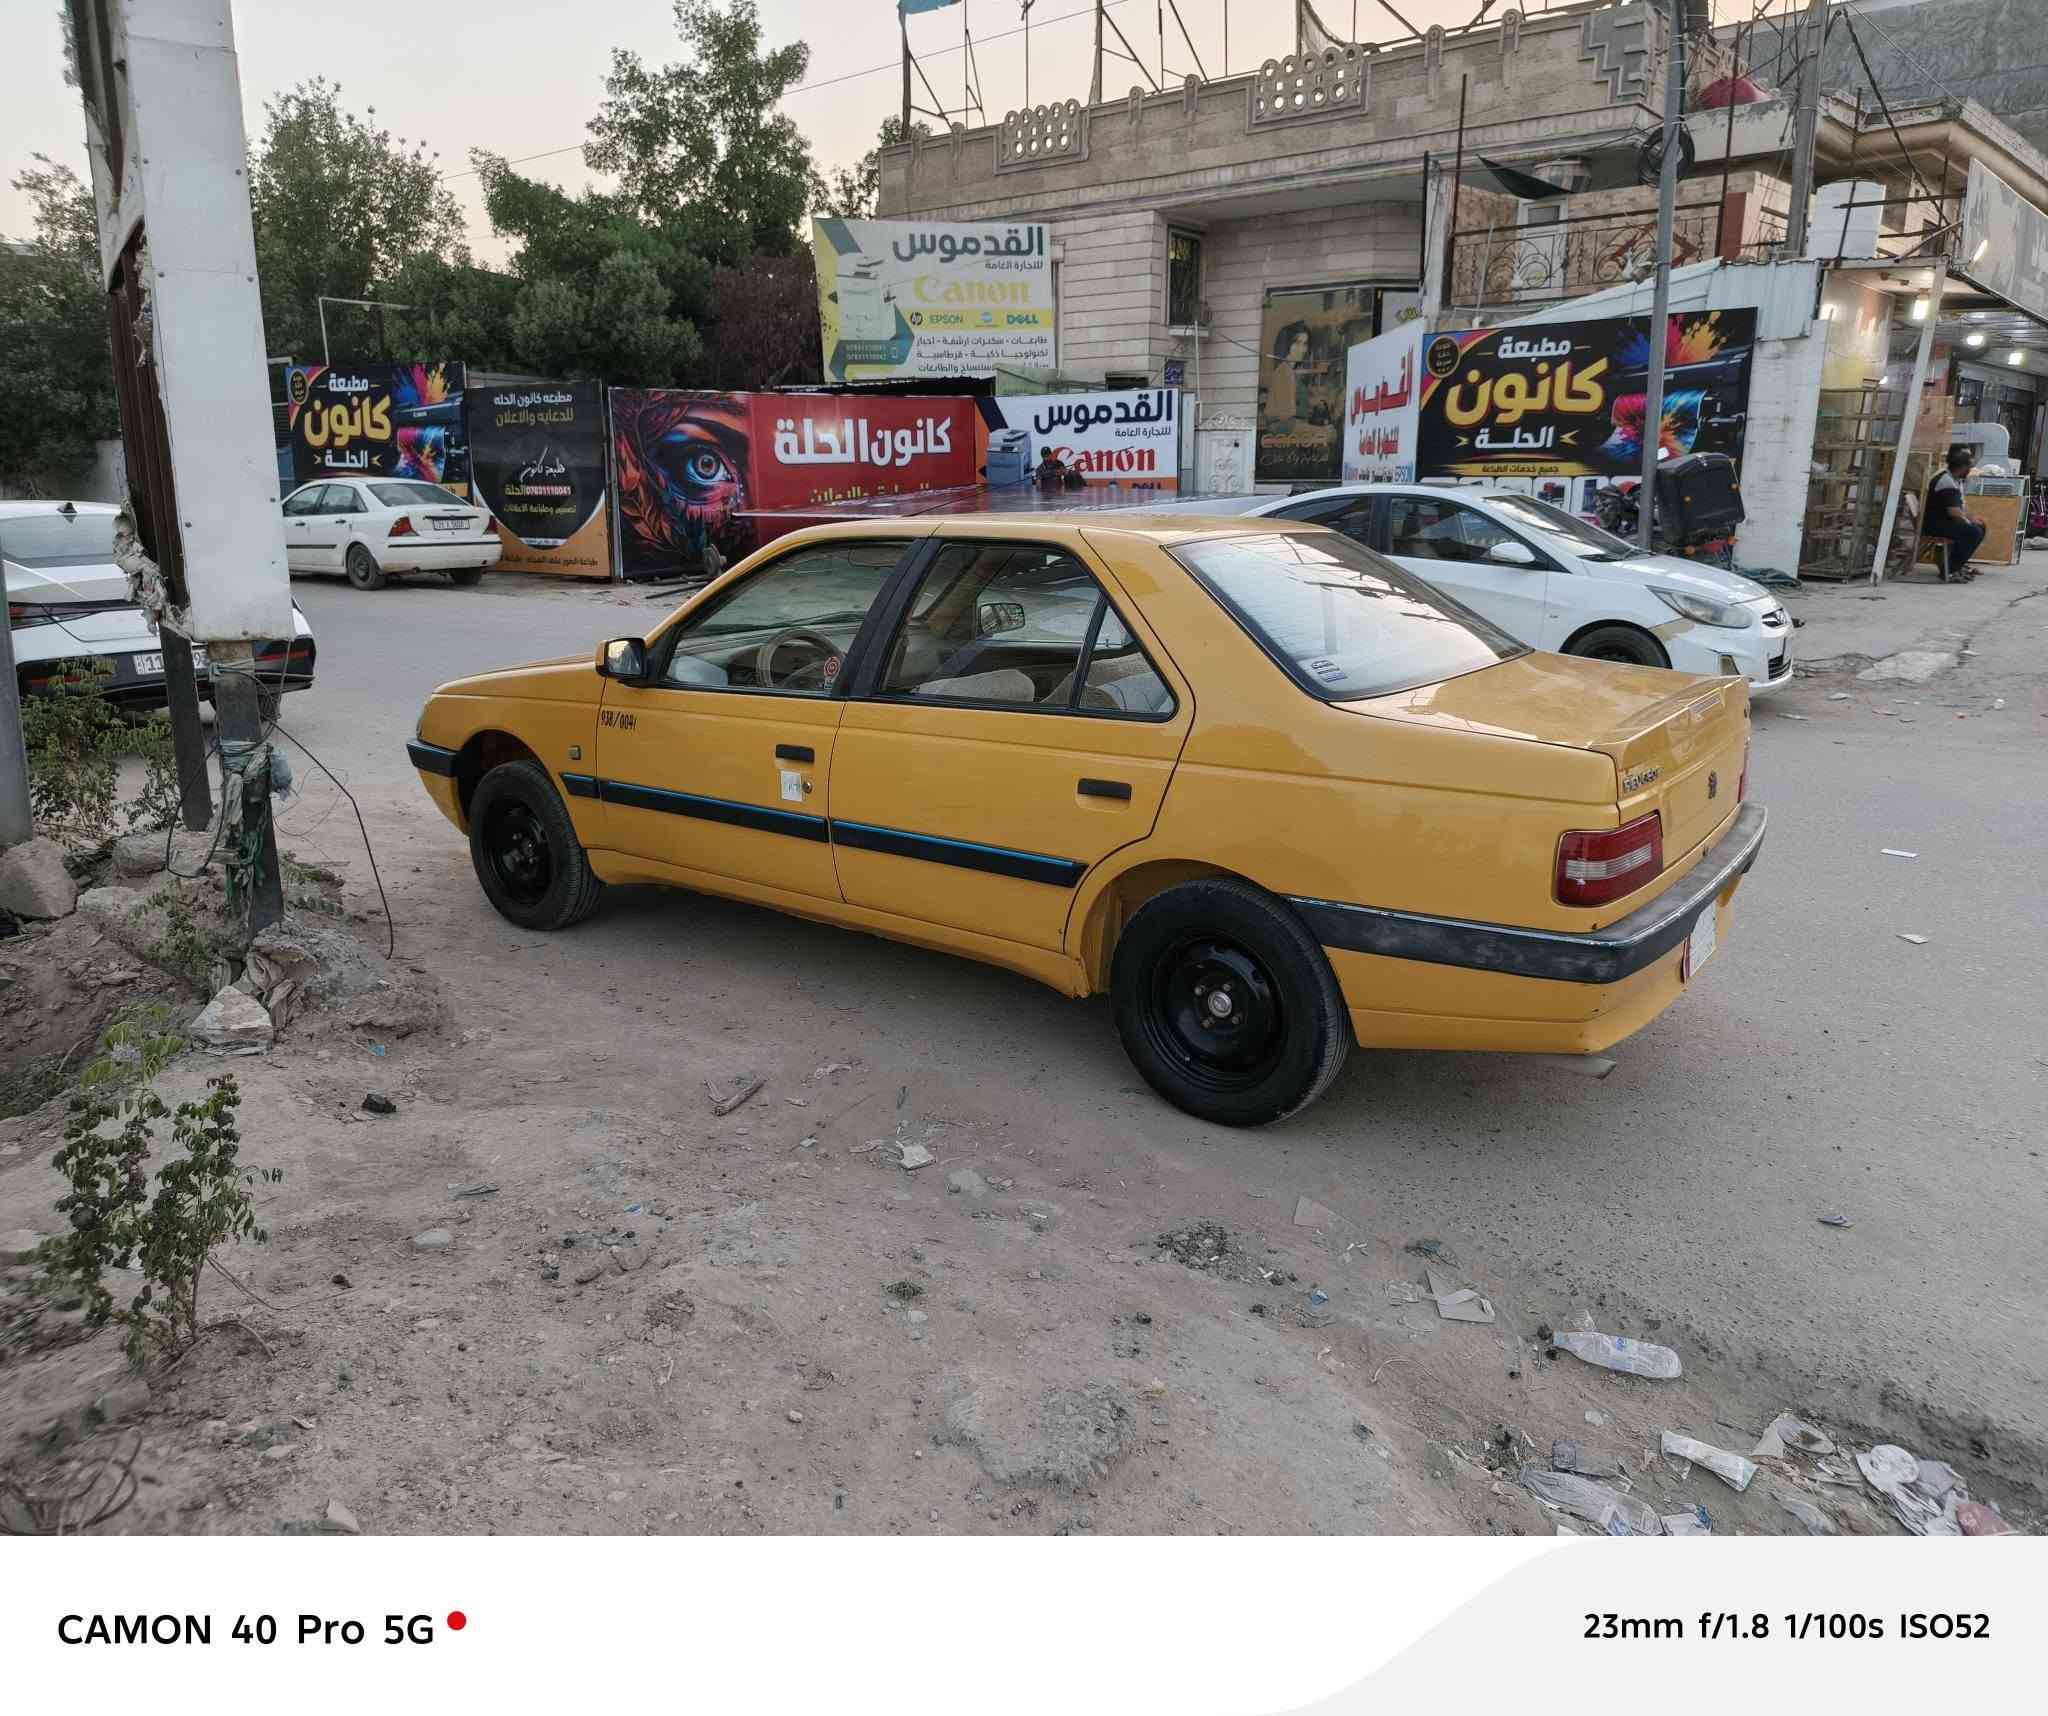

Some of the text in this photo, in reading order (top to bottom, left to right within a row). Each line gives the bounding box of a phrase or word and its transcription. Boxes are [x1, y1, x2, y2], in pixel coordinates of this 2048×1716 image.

[892, 226, 1044, 263] القدموس
[1014, 261, 1044, 272] للتجارة
[912, 273, 1031, 304] Canon
[928, 314, 964, 325] EPSON
[1006, 314, 1040, 325] DELL
[1498, 337, 1571, 362] مطبعة
[329, 373, 368, 396] مطبعة
[1446, 357, 1609, 425] كانون
[517, 391, 542, 408] كانون
[304, 394, 392, 447] كانون
[496, 409, 536, 427] والاعلان
[1034, 390, 1173, 435] القدموس
[774, 417, 951, 466] كانون الحلة
[1115, 425, 1171, 439] للتجارة العامة
[1475, 426, 1555, 449] الحلة
[325, 450, 368, 468] الحلة
